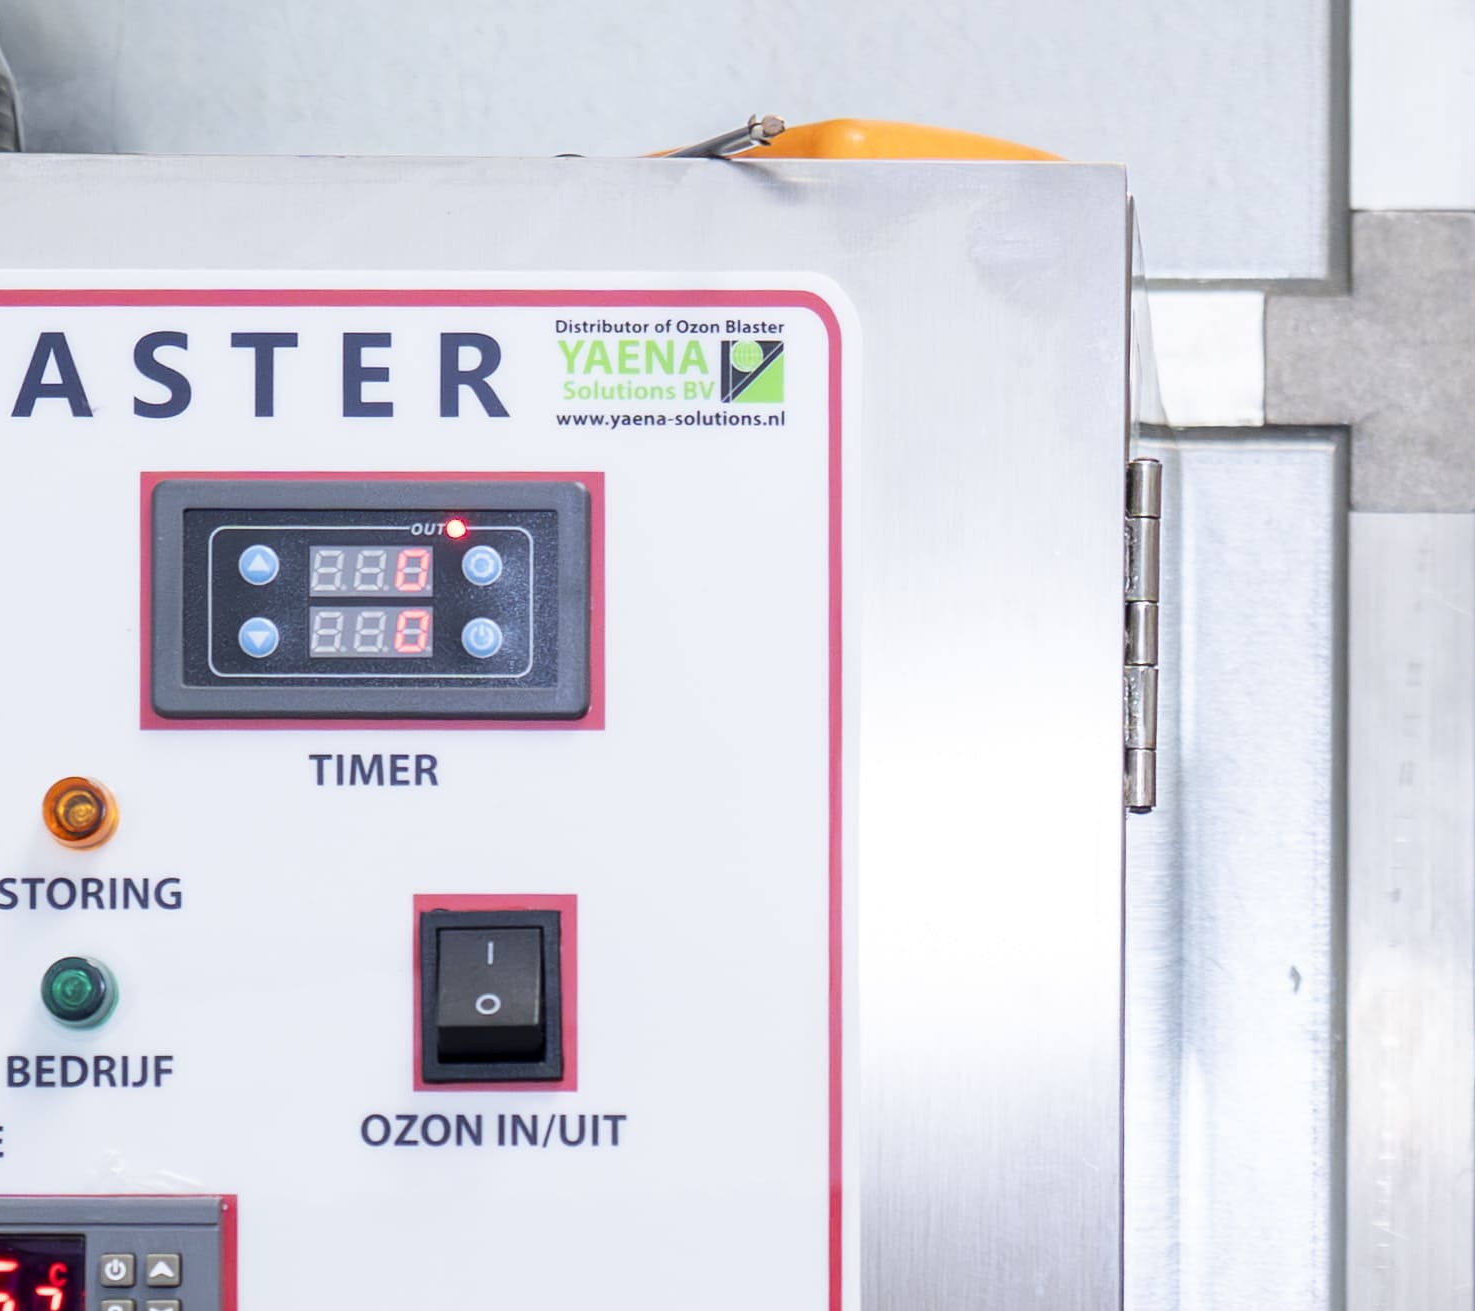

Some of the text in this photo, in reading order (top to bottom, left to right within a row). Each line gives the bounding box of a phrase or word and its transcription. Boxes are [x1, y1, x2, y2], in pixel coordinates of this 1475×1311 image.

[555, 319, 785, 334] Distributor of Ozon Blaster
[558, 338, 708, 375] YAENA
[563, 381, 715, 400] Solutions BV
[556, 410, 785, 429] www.yaena-solutions.nl
[410, 523, 445, 536] OUT
[308, 753, 439, 787] TIMER
[6, 1054, 174, 1088] BEDRIJF
[360, 1113, 627, 1148] OZON IN/UIT
